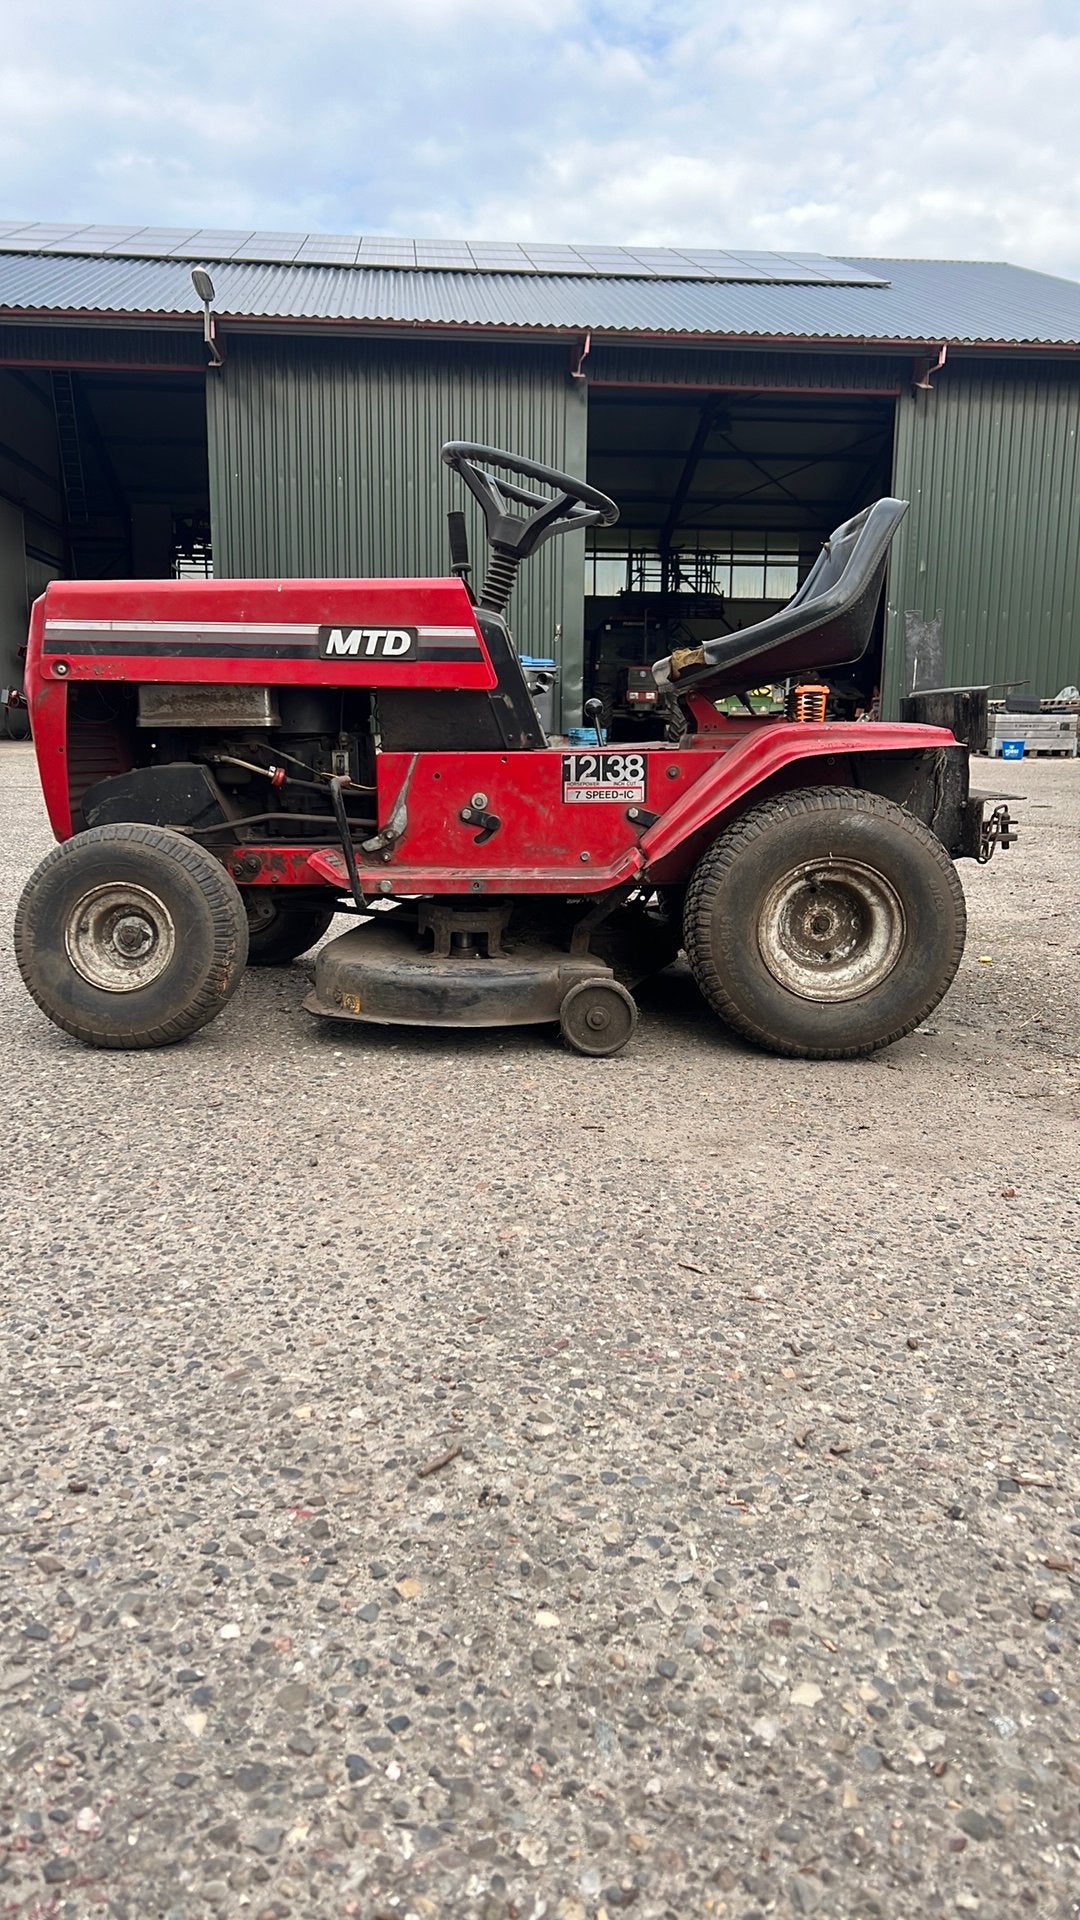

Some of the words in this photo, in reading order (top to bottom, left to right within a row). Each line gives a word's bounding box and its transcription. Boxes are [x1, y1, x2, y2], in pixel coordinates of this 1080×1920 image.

[325, 629, 411, 655] MTD
[575, 790, 581, 799] 7
[585, 790, 634, 799] SPEED-IC
